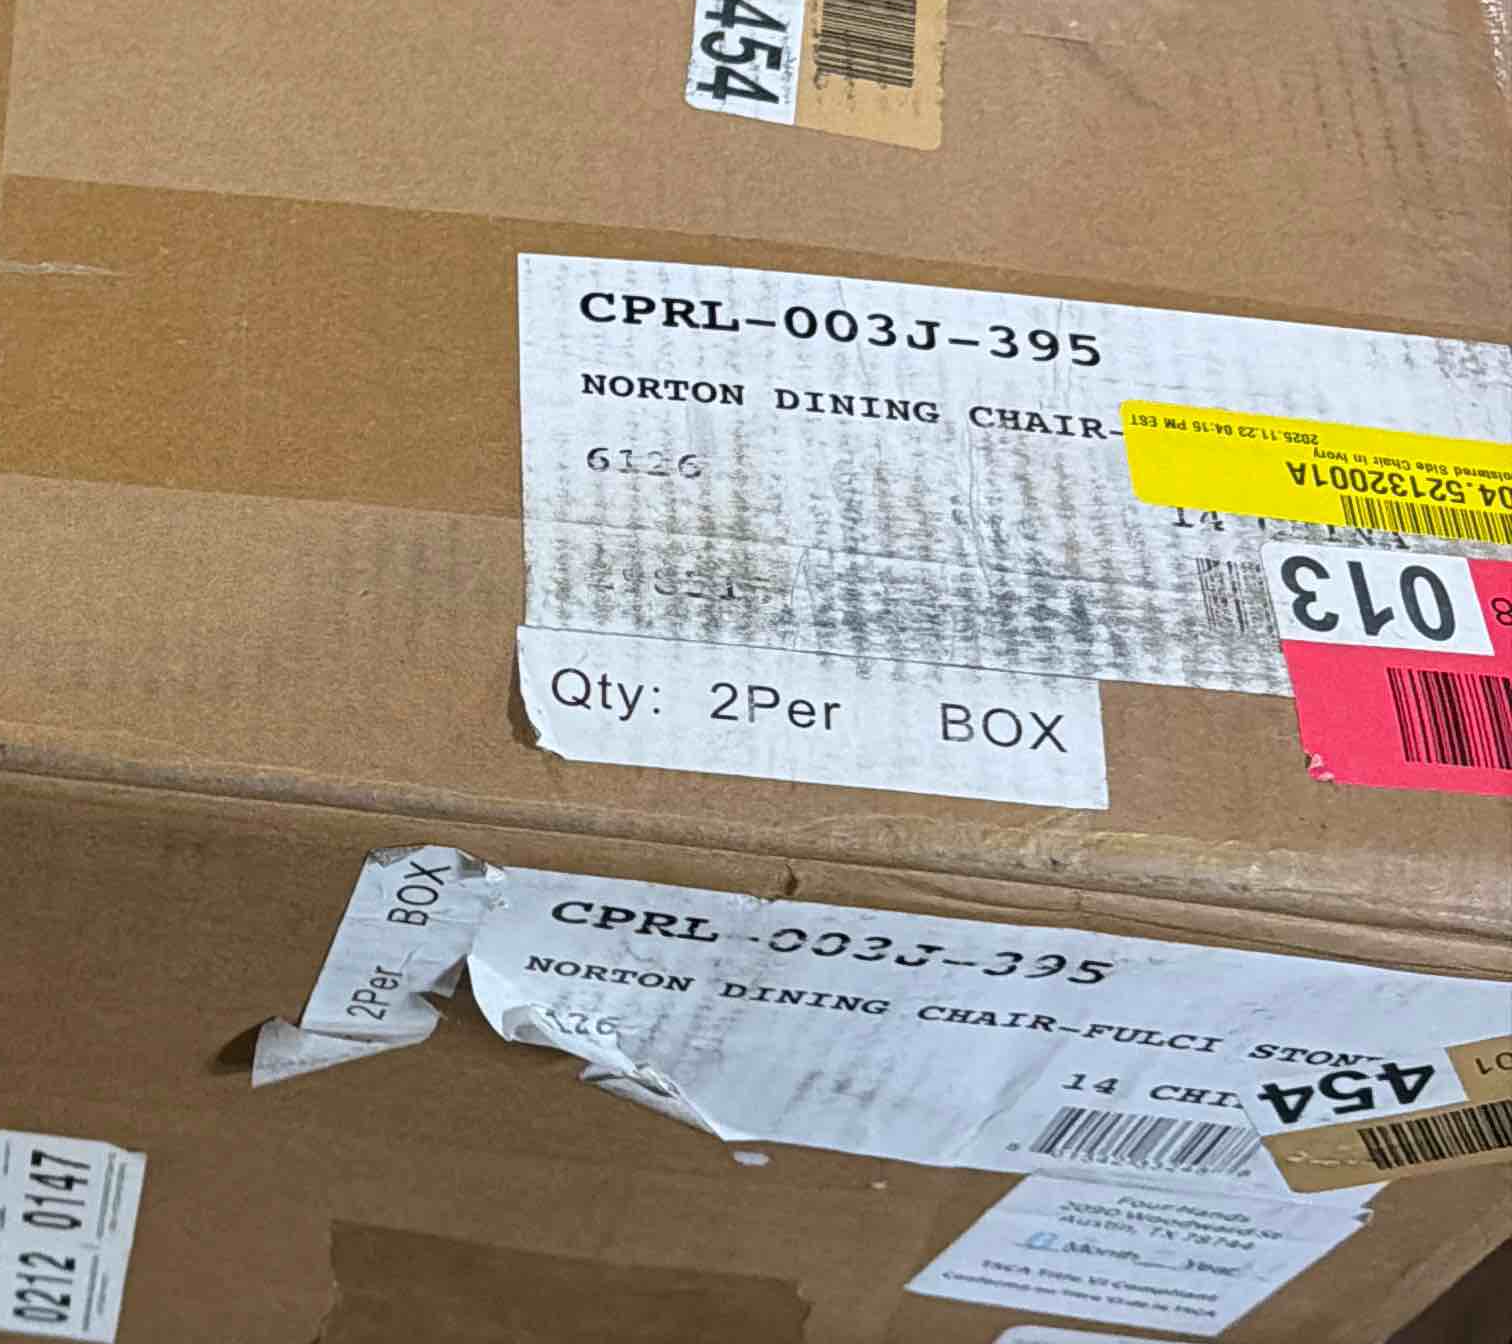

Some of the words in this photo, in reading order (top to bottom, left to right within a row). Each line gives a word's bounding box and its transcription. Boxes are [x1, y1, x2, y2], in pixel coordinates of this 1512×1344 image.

[579, 291, 1101, 367] CPRL-003J-395
[580, 373, 745, 406] NORTON
[773, 387, 940, 424] DINING
[968, 405, 1124, 440] CHAIR-
[1163, 417, 1187, 431] PM
[1415, 461, 1449, 476] Side
[1280, 555, 1456, 642] 013
[550, 667, 662, 722] Qty:
[709, 682, 841, 731] 2Per
[939, 702, 1069, 753] BOX
[345, 964, 404, 1022] 2Per
[386, 860, 452, 928] BOX
[524, 954, 696, 992] NORTON
[719, 981, 891, 1016] DINING
[916, 1005, 1224, 1054] CHAIR-FULCI
[1247, 1043, 1385, 1069] STON
[1061, 1072, 1120, 1095] 14
[1148, 1084, 1245, 1110] CHI
[1256, 1061, 1436, 1125] 454
[22, 1149, 92, 1230] 0147
[12, 1251, 77, 1324] 0212
